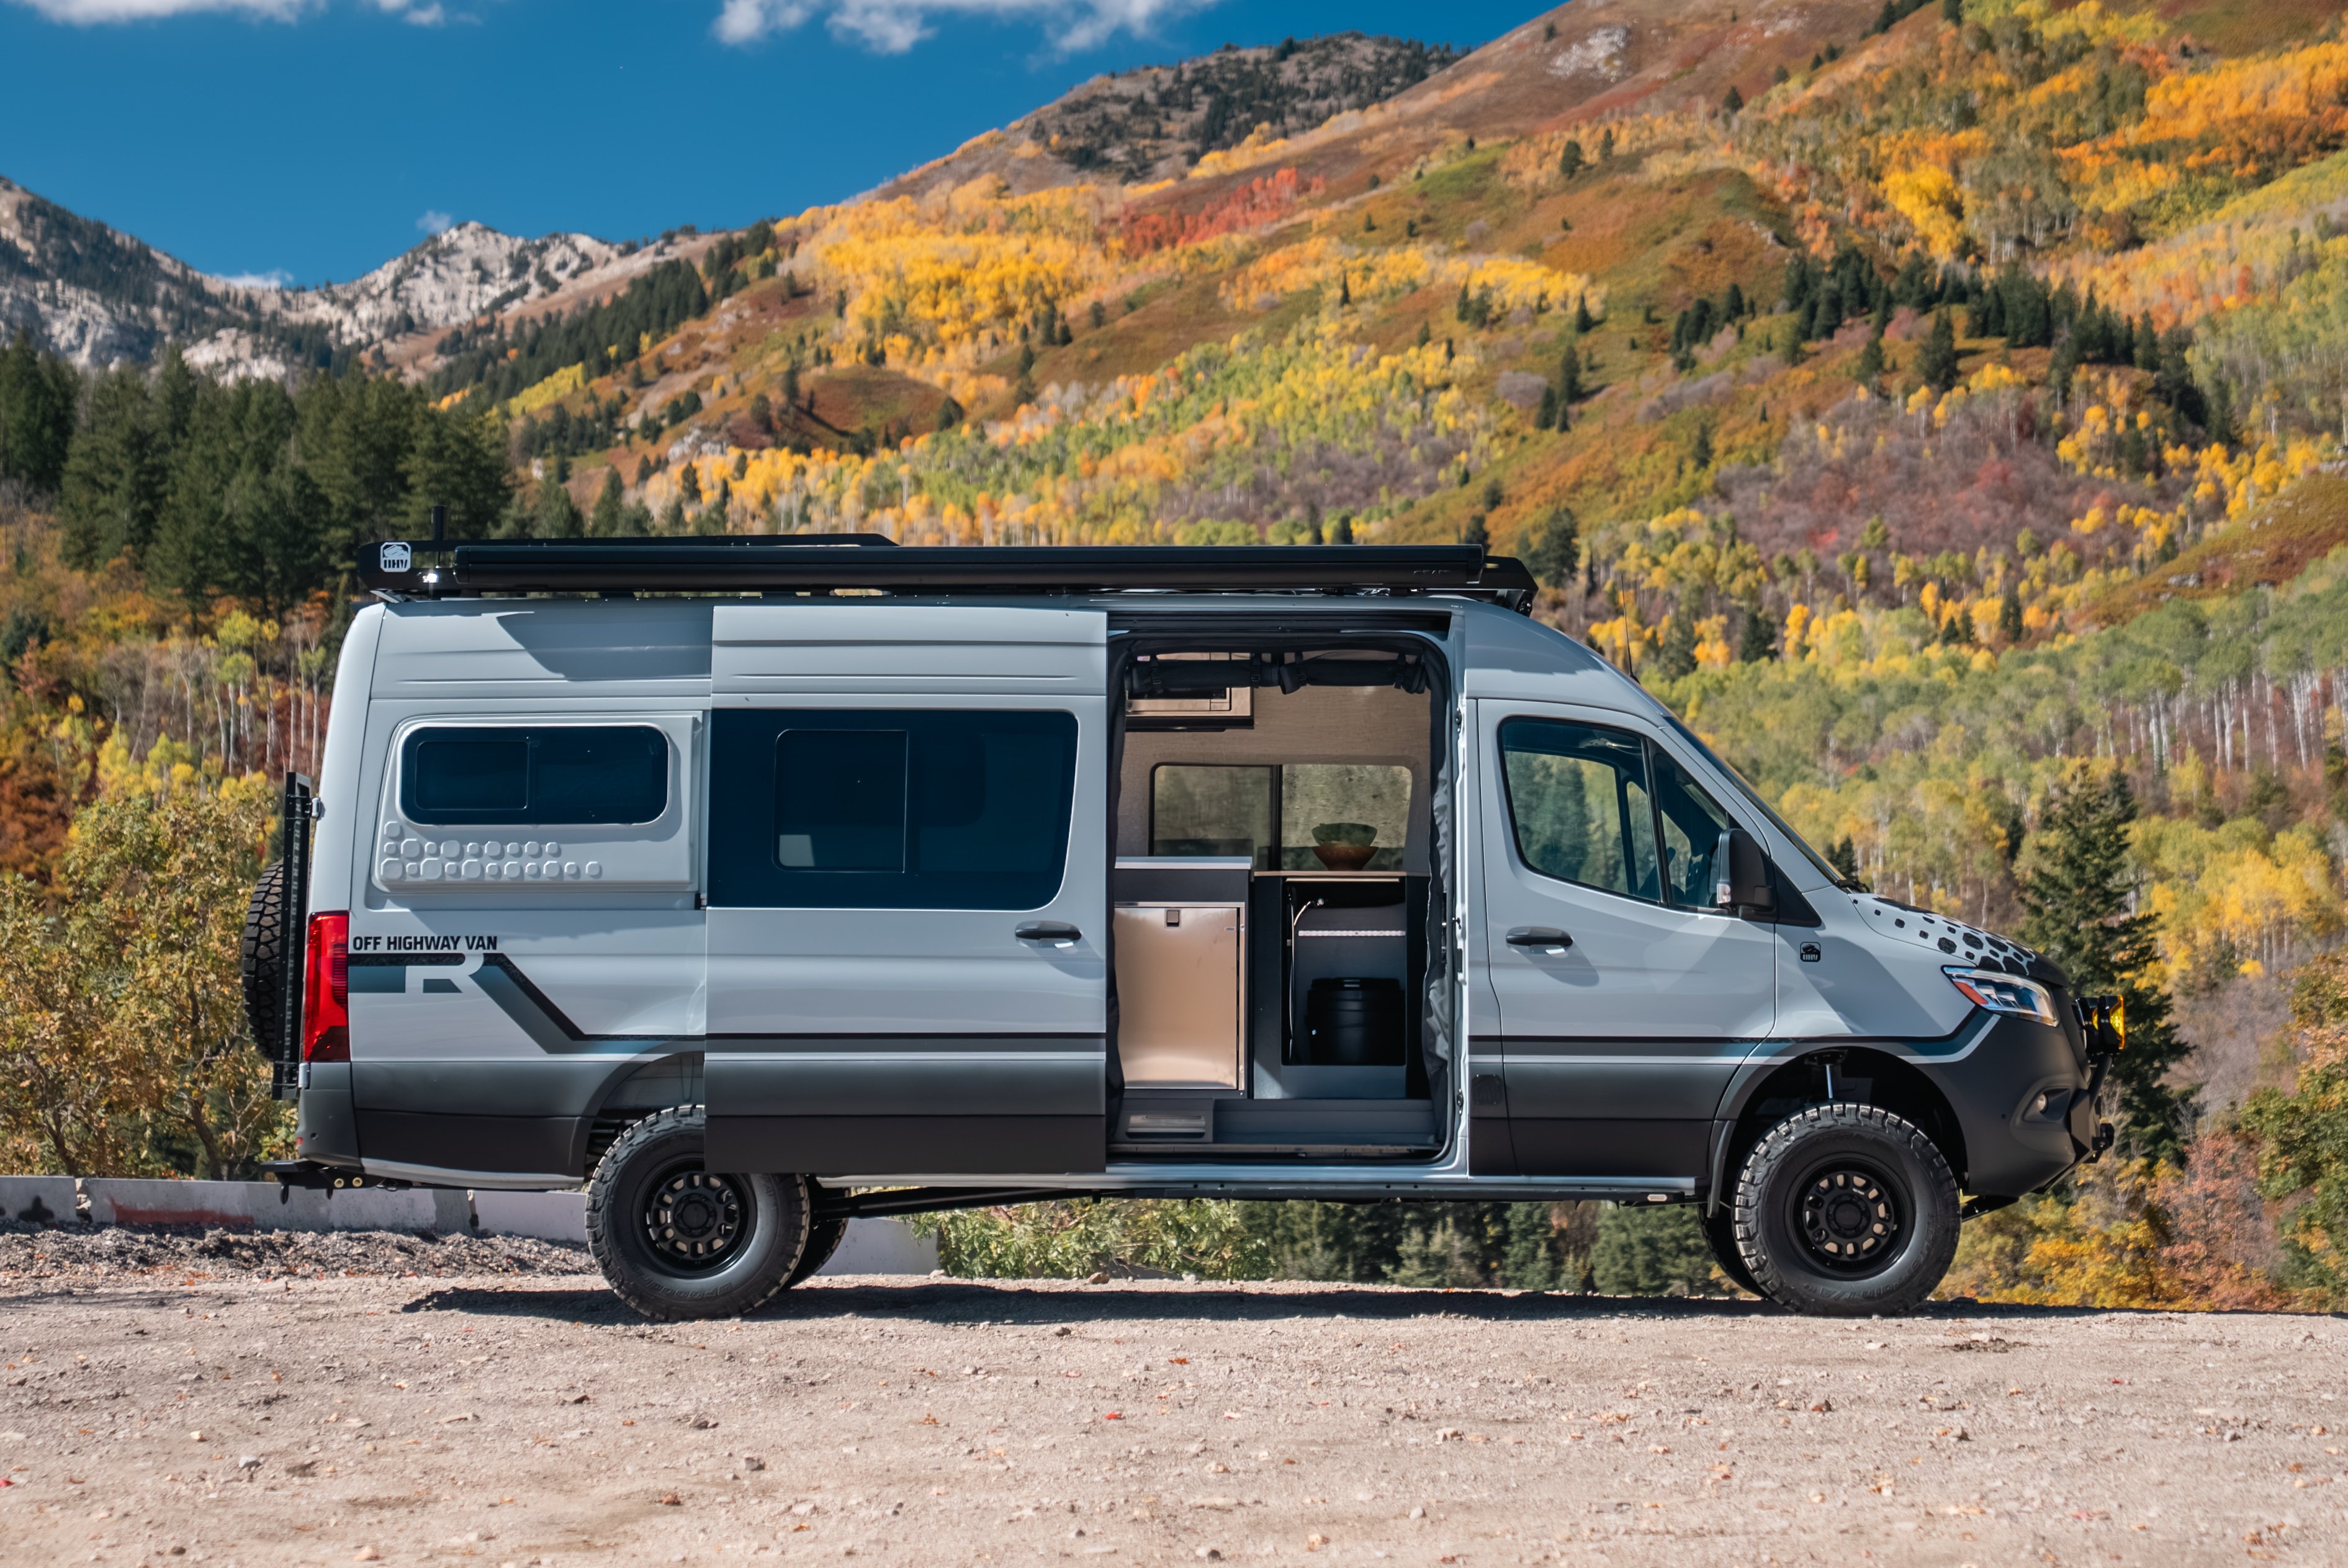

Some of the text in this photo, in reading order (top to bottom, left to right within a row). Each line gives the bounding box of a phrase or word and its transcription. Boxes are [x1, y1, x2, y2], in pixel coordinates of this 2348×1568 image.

[384, 559, 408, 568] OHV
[353, 935, 498, 951] OFF HIGHWAY VAN
